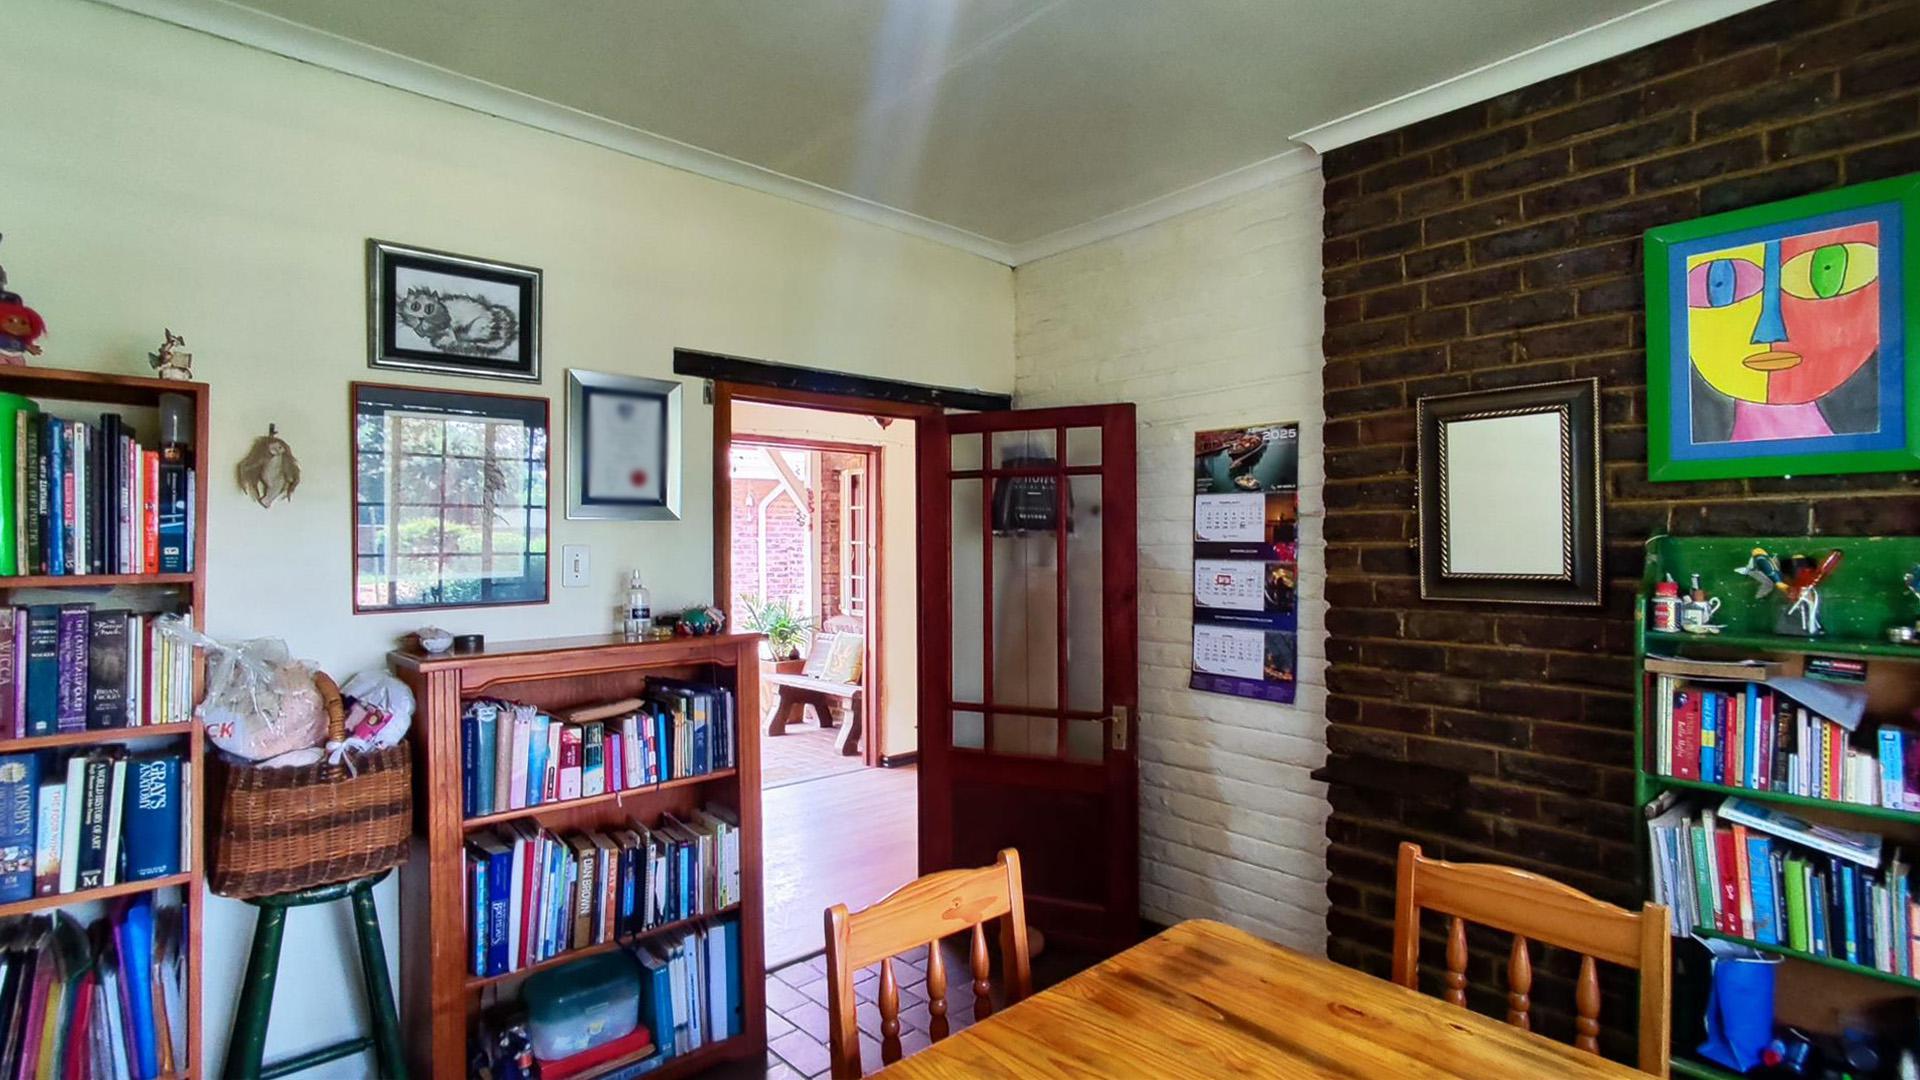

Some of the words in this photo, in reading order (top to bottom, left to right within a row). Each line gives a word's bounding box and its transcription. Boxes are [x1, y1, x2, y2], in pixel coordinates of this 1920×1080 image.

[1262, 428, 1297, 440] 2025
[39, 480, 48, 515] ZENTANGLE
[29, 507, 38, 547] POETRY
[0, 639, 12, 686] WICCA
[95, 769, 105, 795] WORLD
[138, 762, 150, 810] ANATOMY
[150, 760, 167, 810] GRAY'S
[14, 784, 31, 836] MOSBY'S
[91, 834, 101, 850] ART
[583, 858, 593, 878] DAN
[580, 879, 592, 915] BROWN
